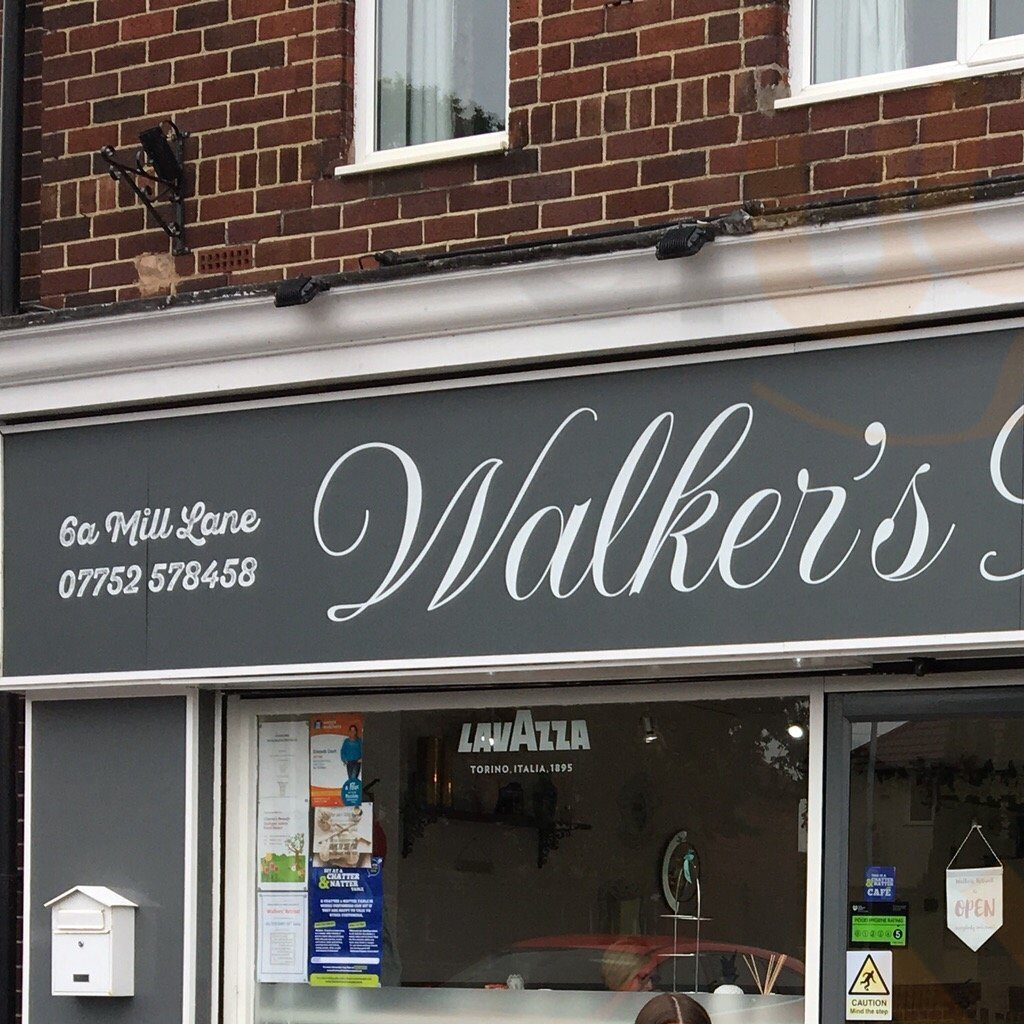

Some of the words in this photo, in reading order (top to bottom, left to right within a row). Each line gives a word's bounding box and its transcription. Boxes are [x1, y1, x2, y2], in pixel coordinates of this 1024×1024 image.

[59, 515, 100, 547] 6a
[105, 507, 173, 546] Mill
[176, 501, 261, 546] Lane
[314, 402, 956, 623] Walker's
[58, 564, 142, 599] 07752
[148, 556, 258, 593] 578458
[457, 710, 591, 752] LAVAZZA
[550, 762, 573, 773] 1895
[955, 898, 995, 918] OPEN
